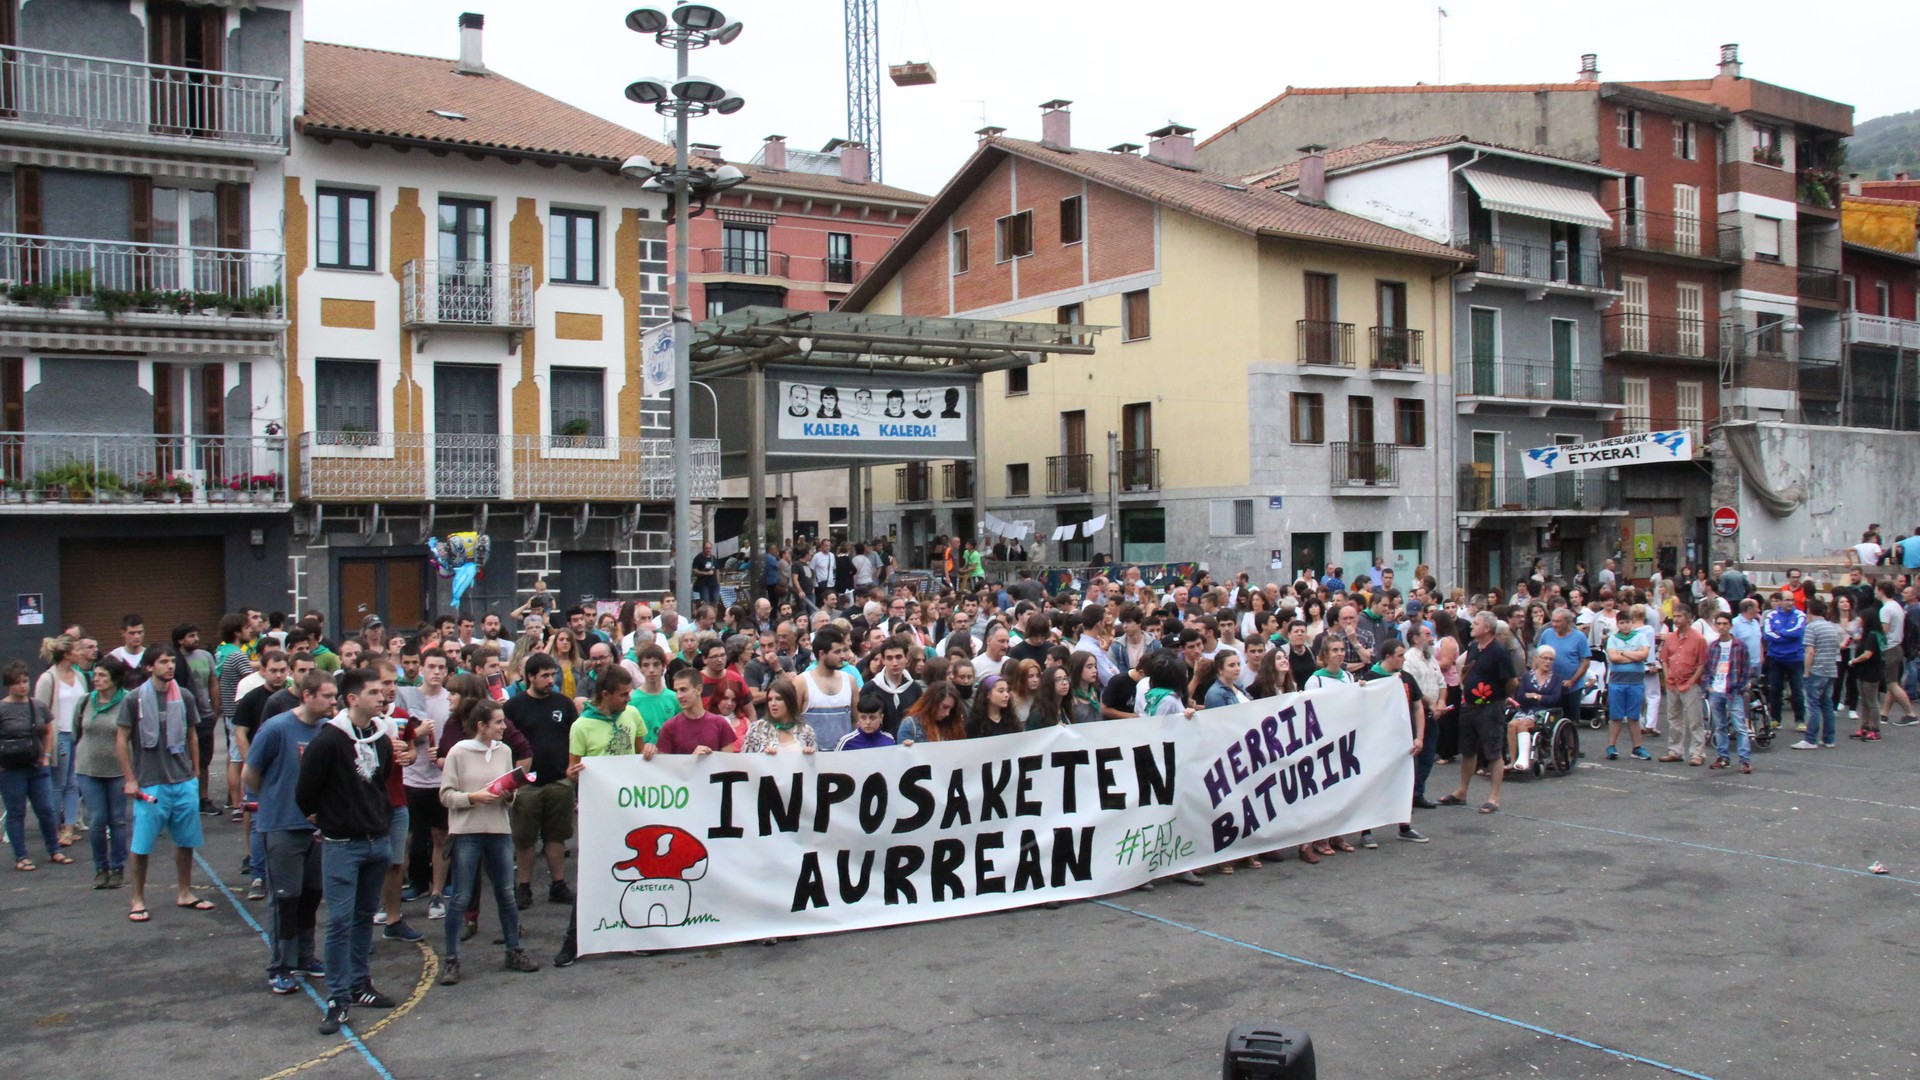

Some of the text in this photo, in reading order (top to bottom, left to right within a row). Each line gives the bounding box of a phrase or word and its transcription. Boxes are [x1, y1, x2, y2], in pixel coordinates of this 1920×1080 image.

[803, 423, 937, 437] KALERA KALERA!
[1560, 444, 1584, 453] PRESO
[1588, 442, 1599, 450] TA
[1568, 446, 1641, 465] ETXERA!
[1203, 699, 1324, 810] HERRIA
[618, 785, 689, 809] ONDDO
[708, 741, 1175, 838] INPOSAKETEN
[1211, 729, 1361, 853] BATURIK
[1115, 817, 1177, 866] #EAJ
[791, 826, 1095, 912] AURREAN
